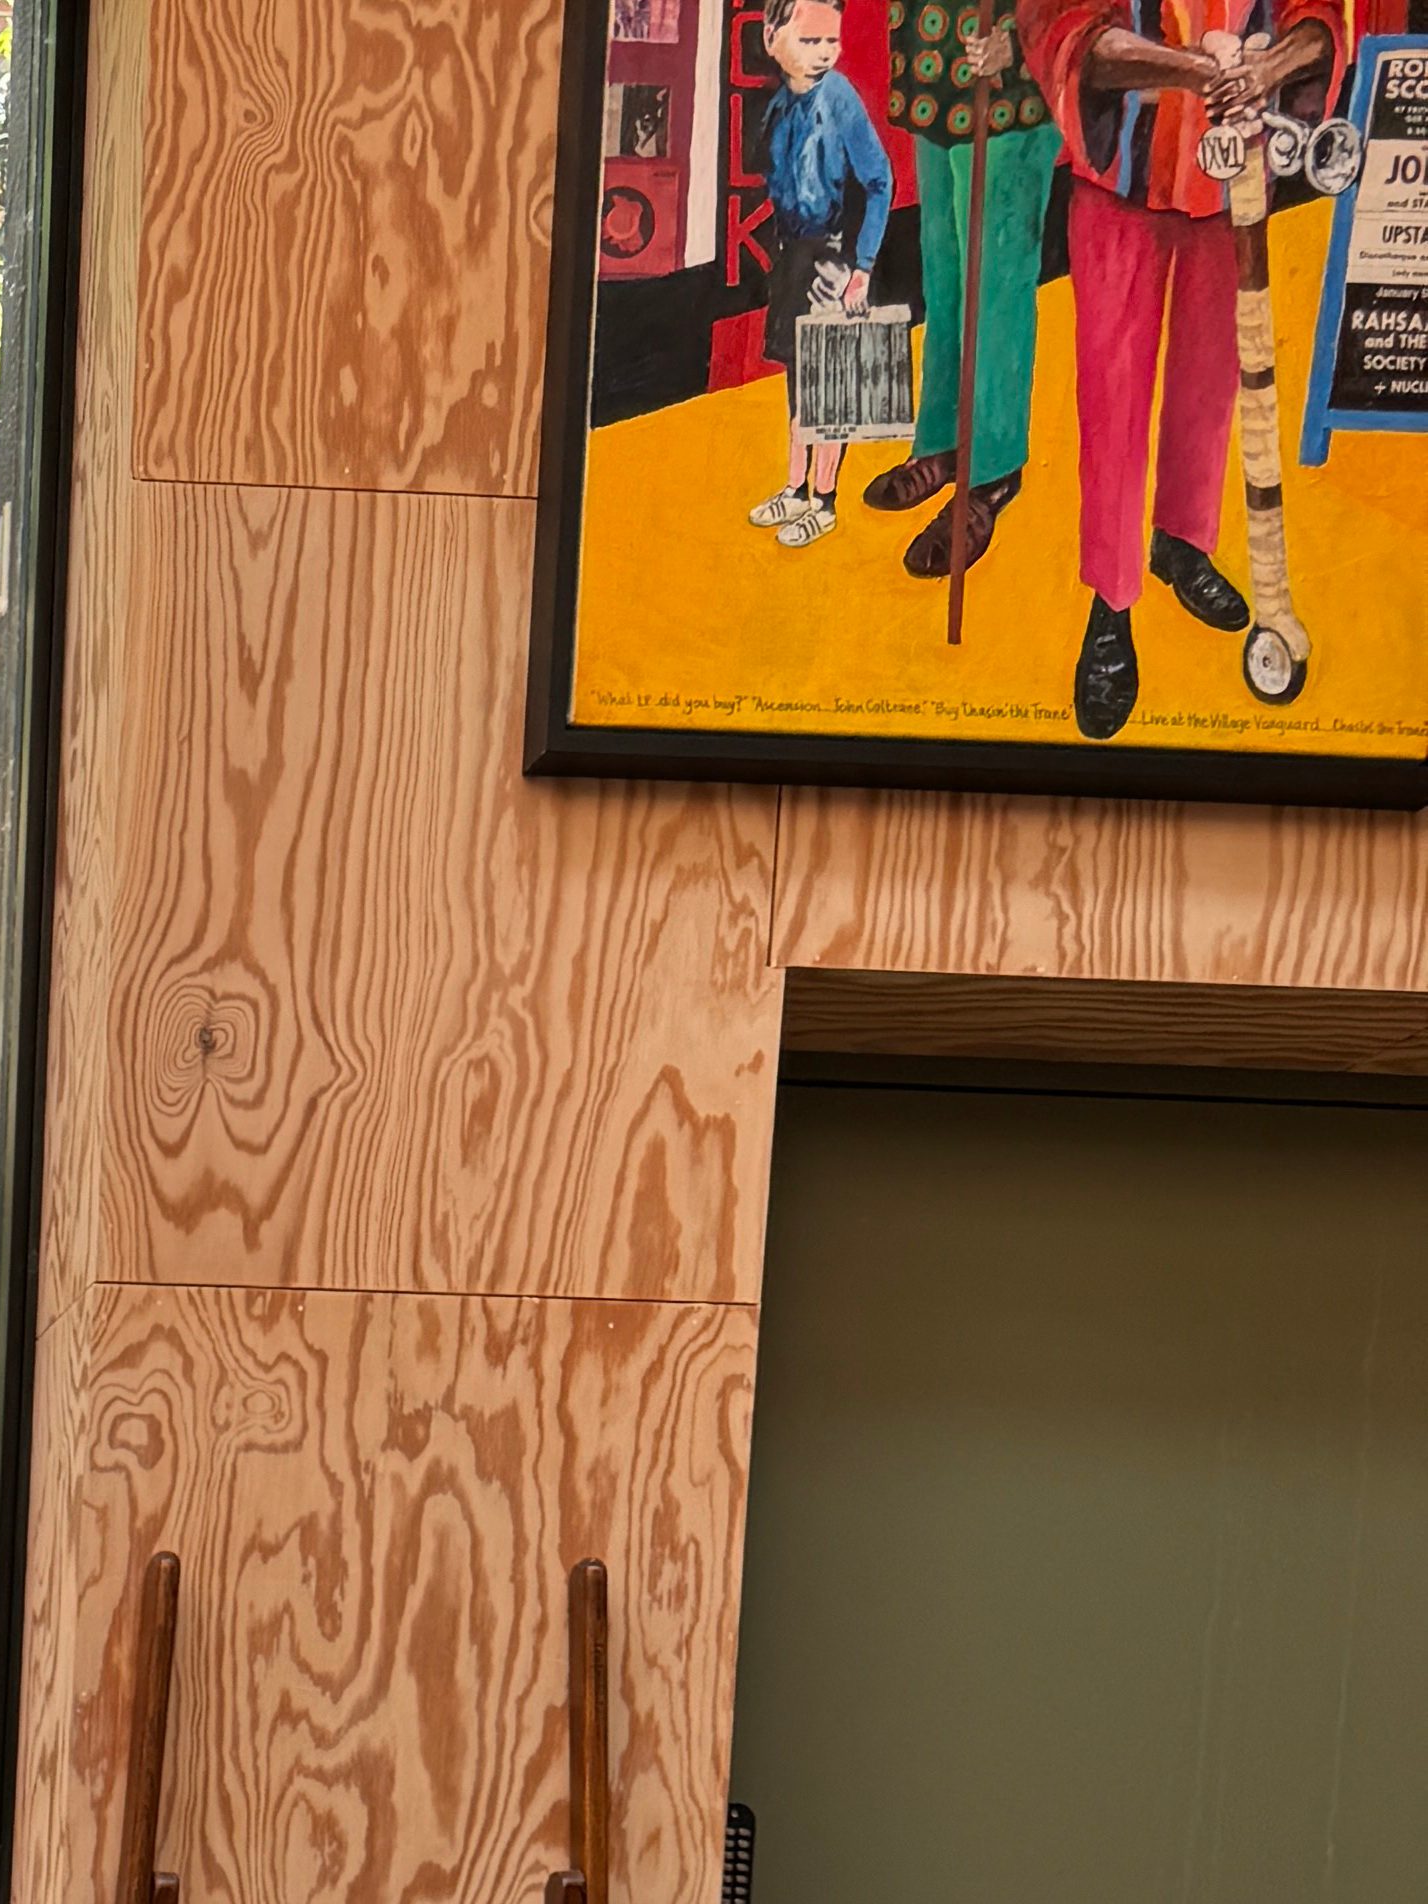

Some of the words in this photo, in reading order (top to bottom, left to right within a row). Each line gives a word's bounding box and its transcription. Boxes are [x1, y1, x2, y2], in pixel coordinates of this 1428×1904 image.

[1388, 59, 1428, 78] RO
[1201, 135, 1244, 171] TAXI
[1384, 155, 1428, 186] JO
[1376, 286, 1419, 301] January
[1351, 309, 1428, 331] RAHSA
[1364, 332, 1394, 349] and
[1400, 334, 1428, 349] THE
[1363, 355, 1426, 371] SOCIETY
[685, 698, 710, 715] you
[1209, 713, 1251, 734] Village
[1254, 715, 1320, 736] Vanguard
